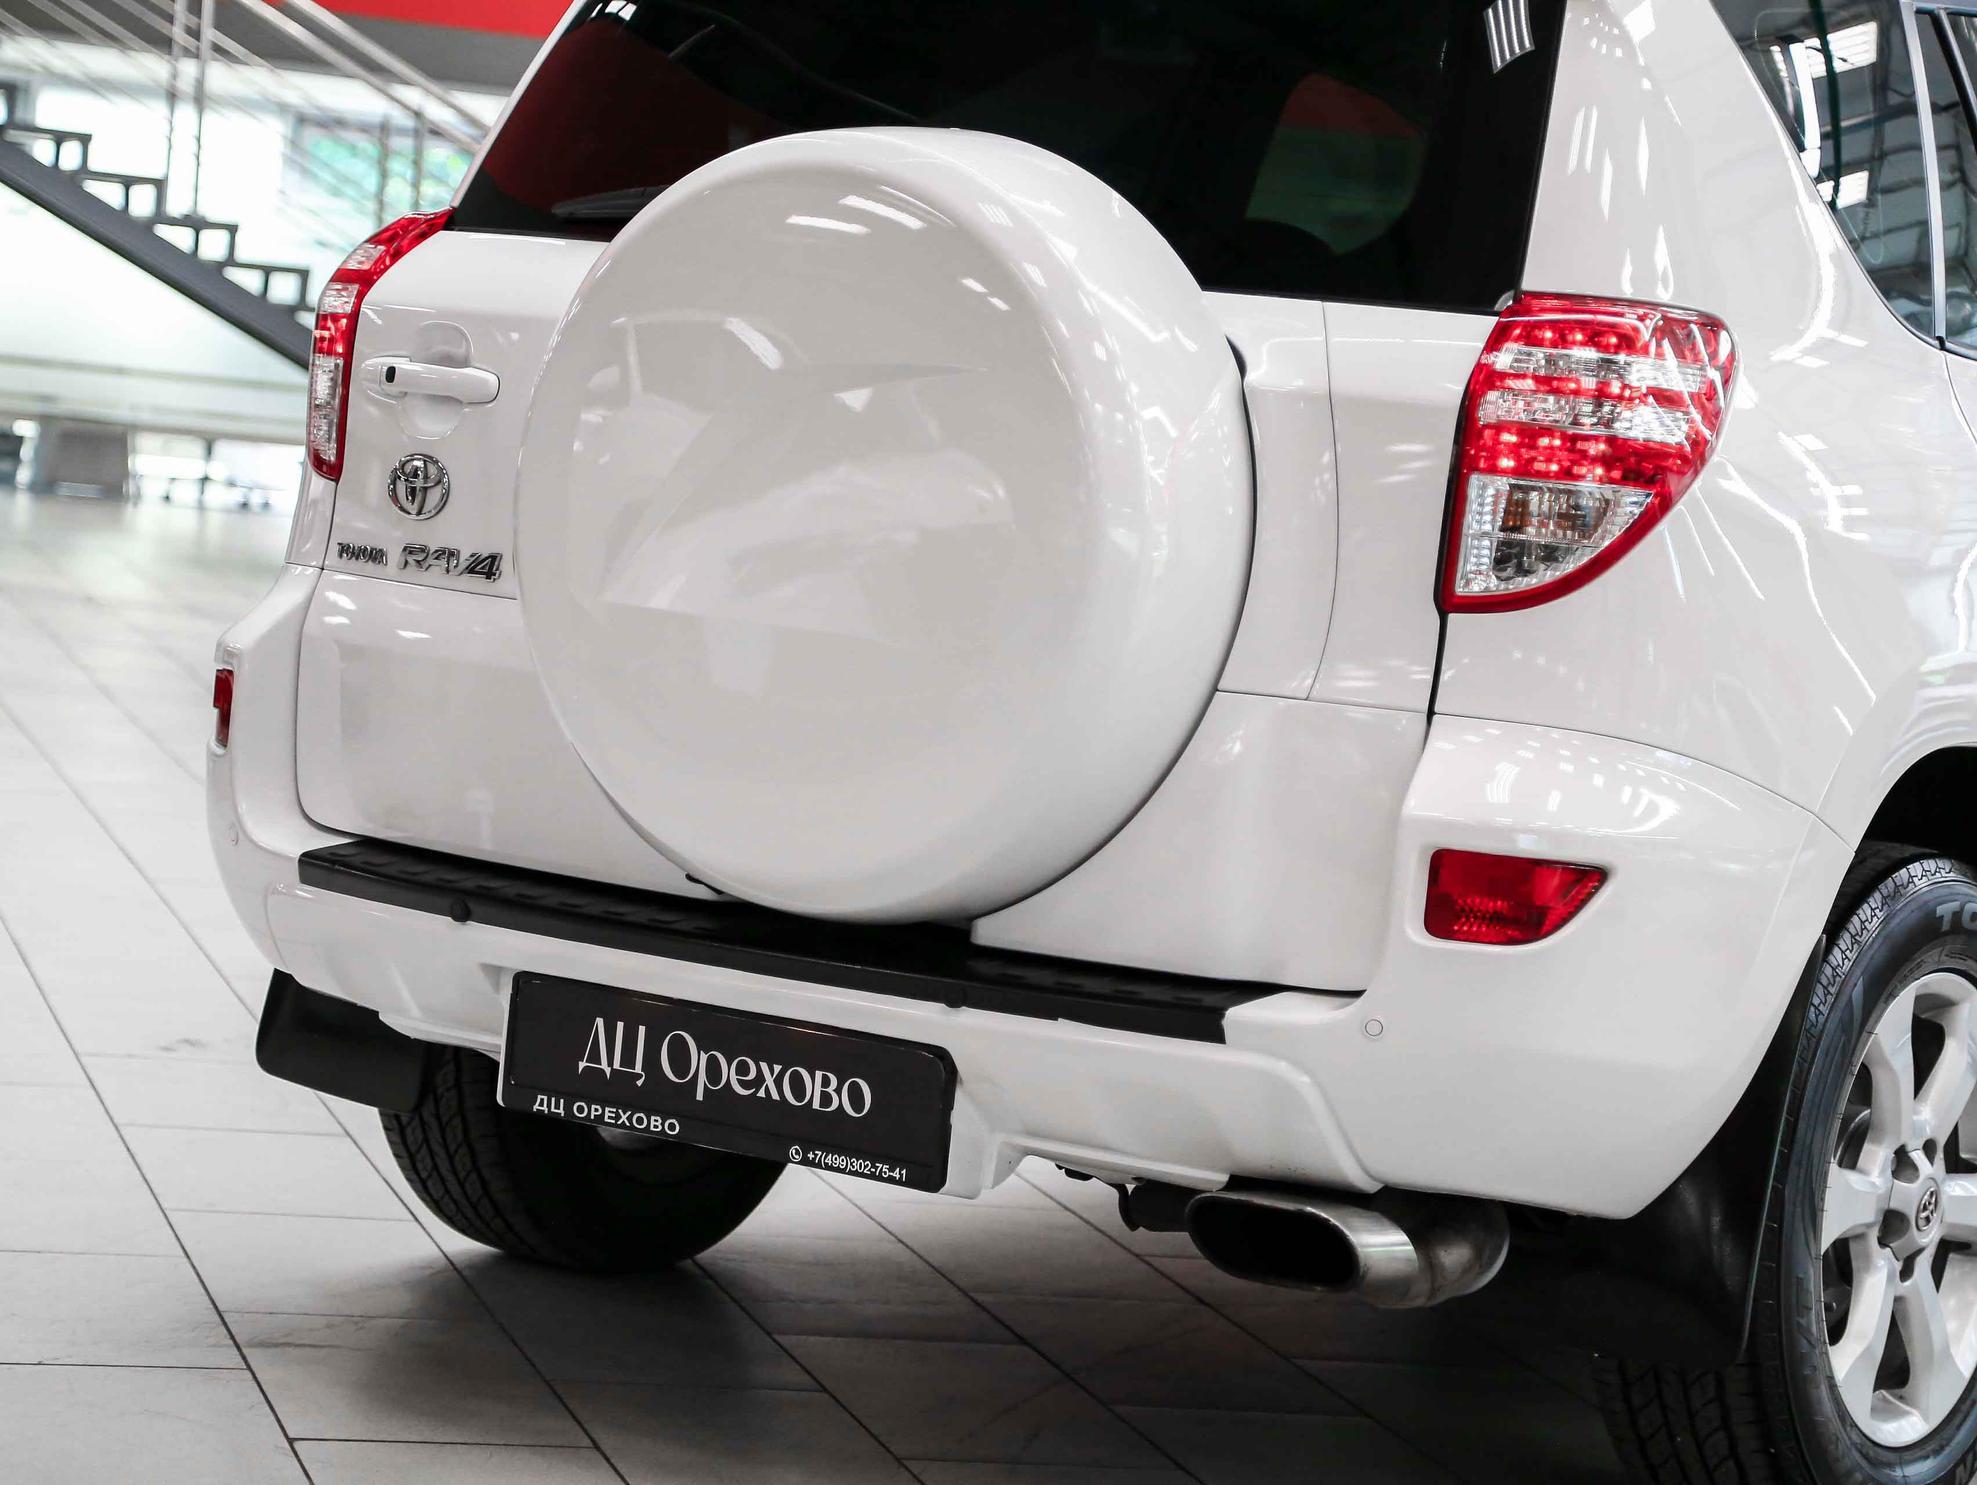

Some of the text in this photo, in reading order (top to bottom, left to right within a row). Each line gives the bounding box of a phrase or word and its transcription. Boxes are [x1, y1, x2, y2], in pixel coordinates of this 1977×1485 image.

[399, 543, 502, 583] RAV4
[578, 1017, 646, 1087] ДЦ
[533, 1094, 680, 1136] ДЦ ОРЕХОВО
[807, 1151, 907, 1182] +7(499)302-75-41
